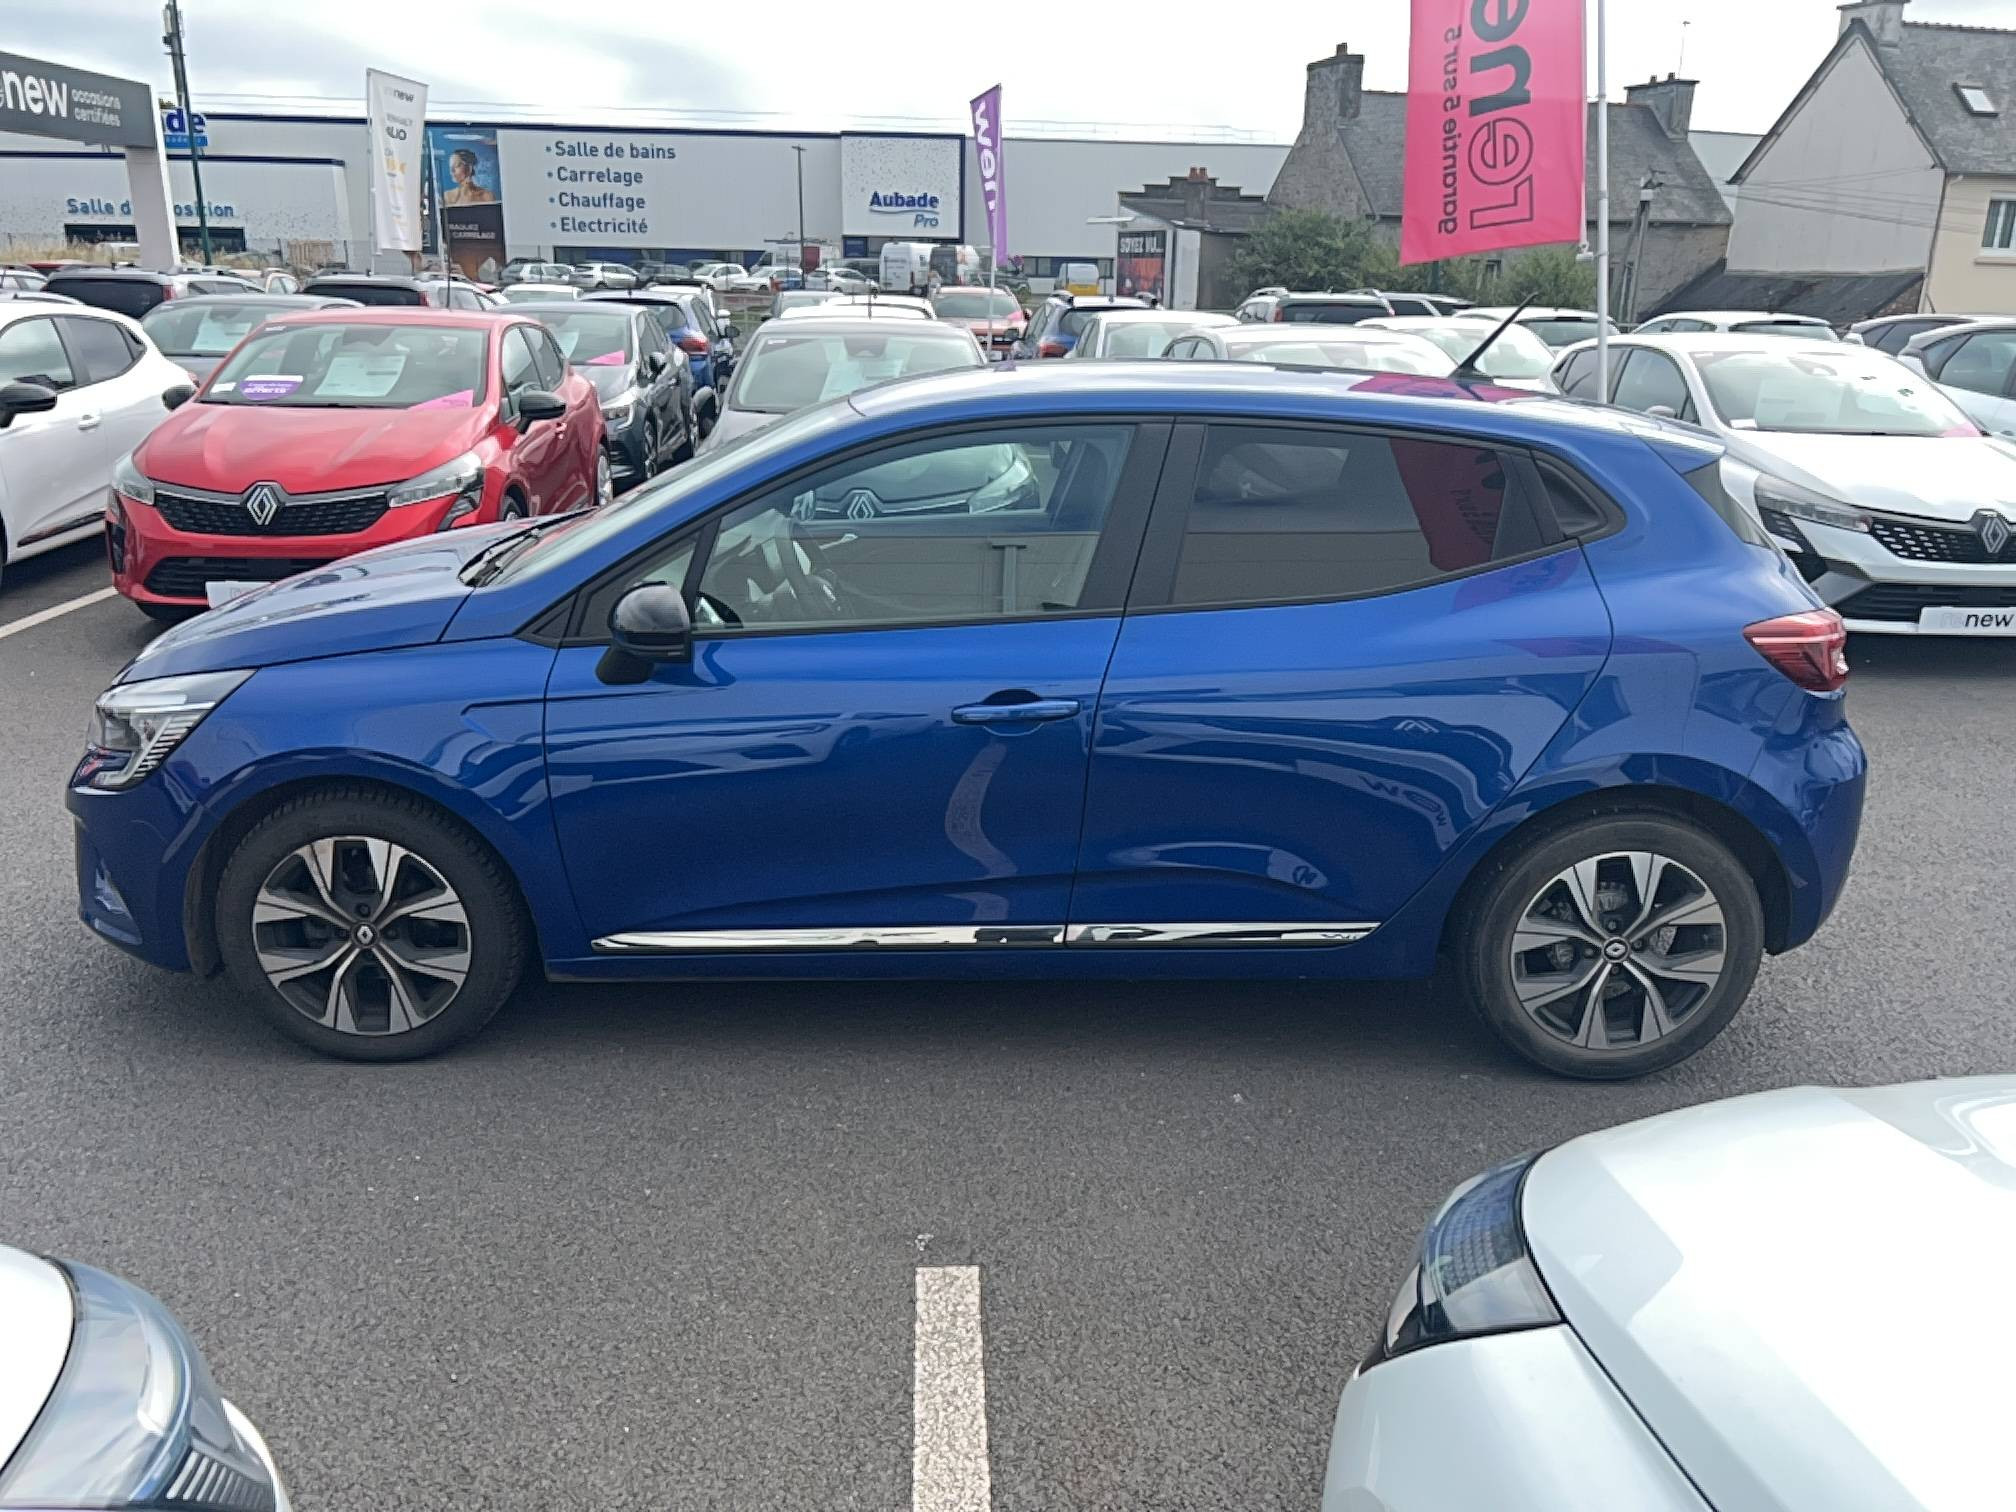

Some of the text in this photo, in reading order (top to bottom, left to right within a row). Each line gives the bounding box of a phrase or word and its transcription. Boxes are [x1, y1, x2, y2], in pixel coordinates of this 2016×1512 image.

[0, 70, 67, 117] new
[555, 140, 676, 159] Salle de bains
[557, 166, 643, 187] Carrelage
[67, 198, 114, 215] Salle
[558, 192, 646, 212] Chauffage
[869, 191, 940, 208] Aubade
[560, 216, 648, 234] Electricité
[914, 214, 939, 227] Pro
